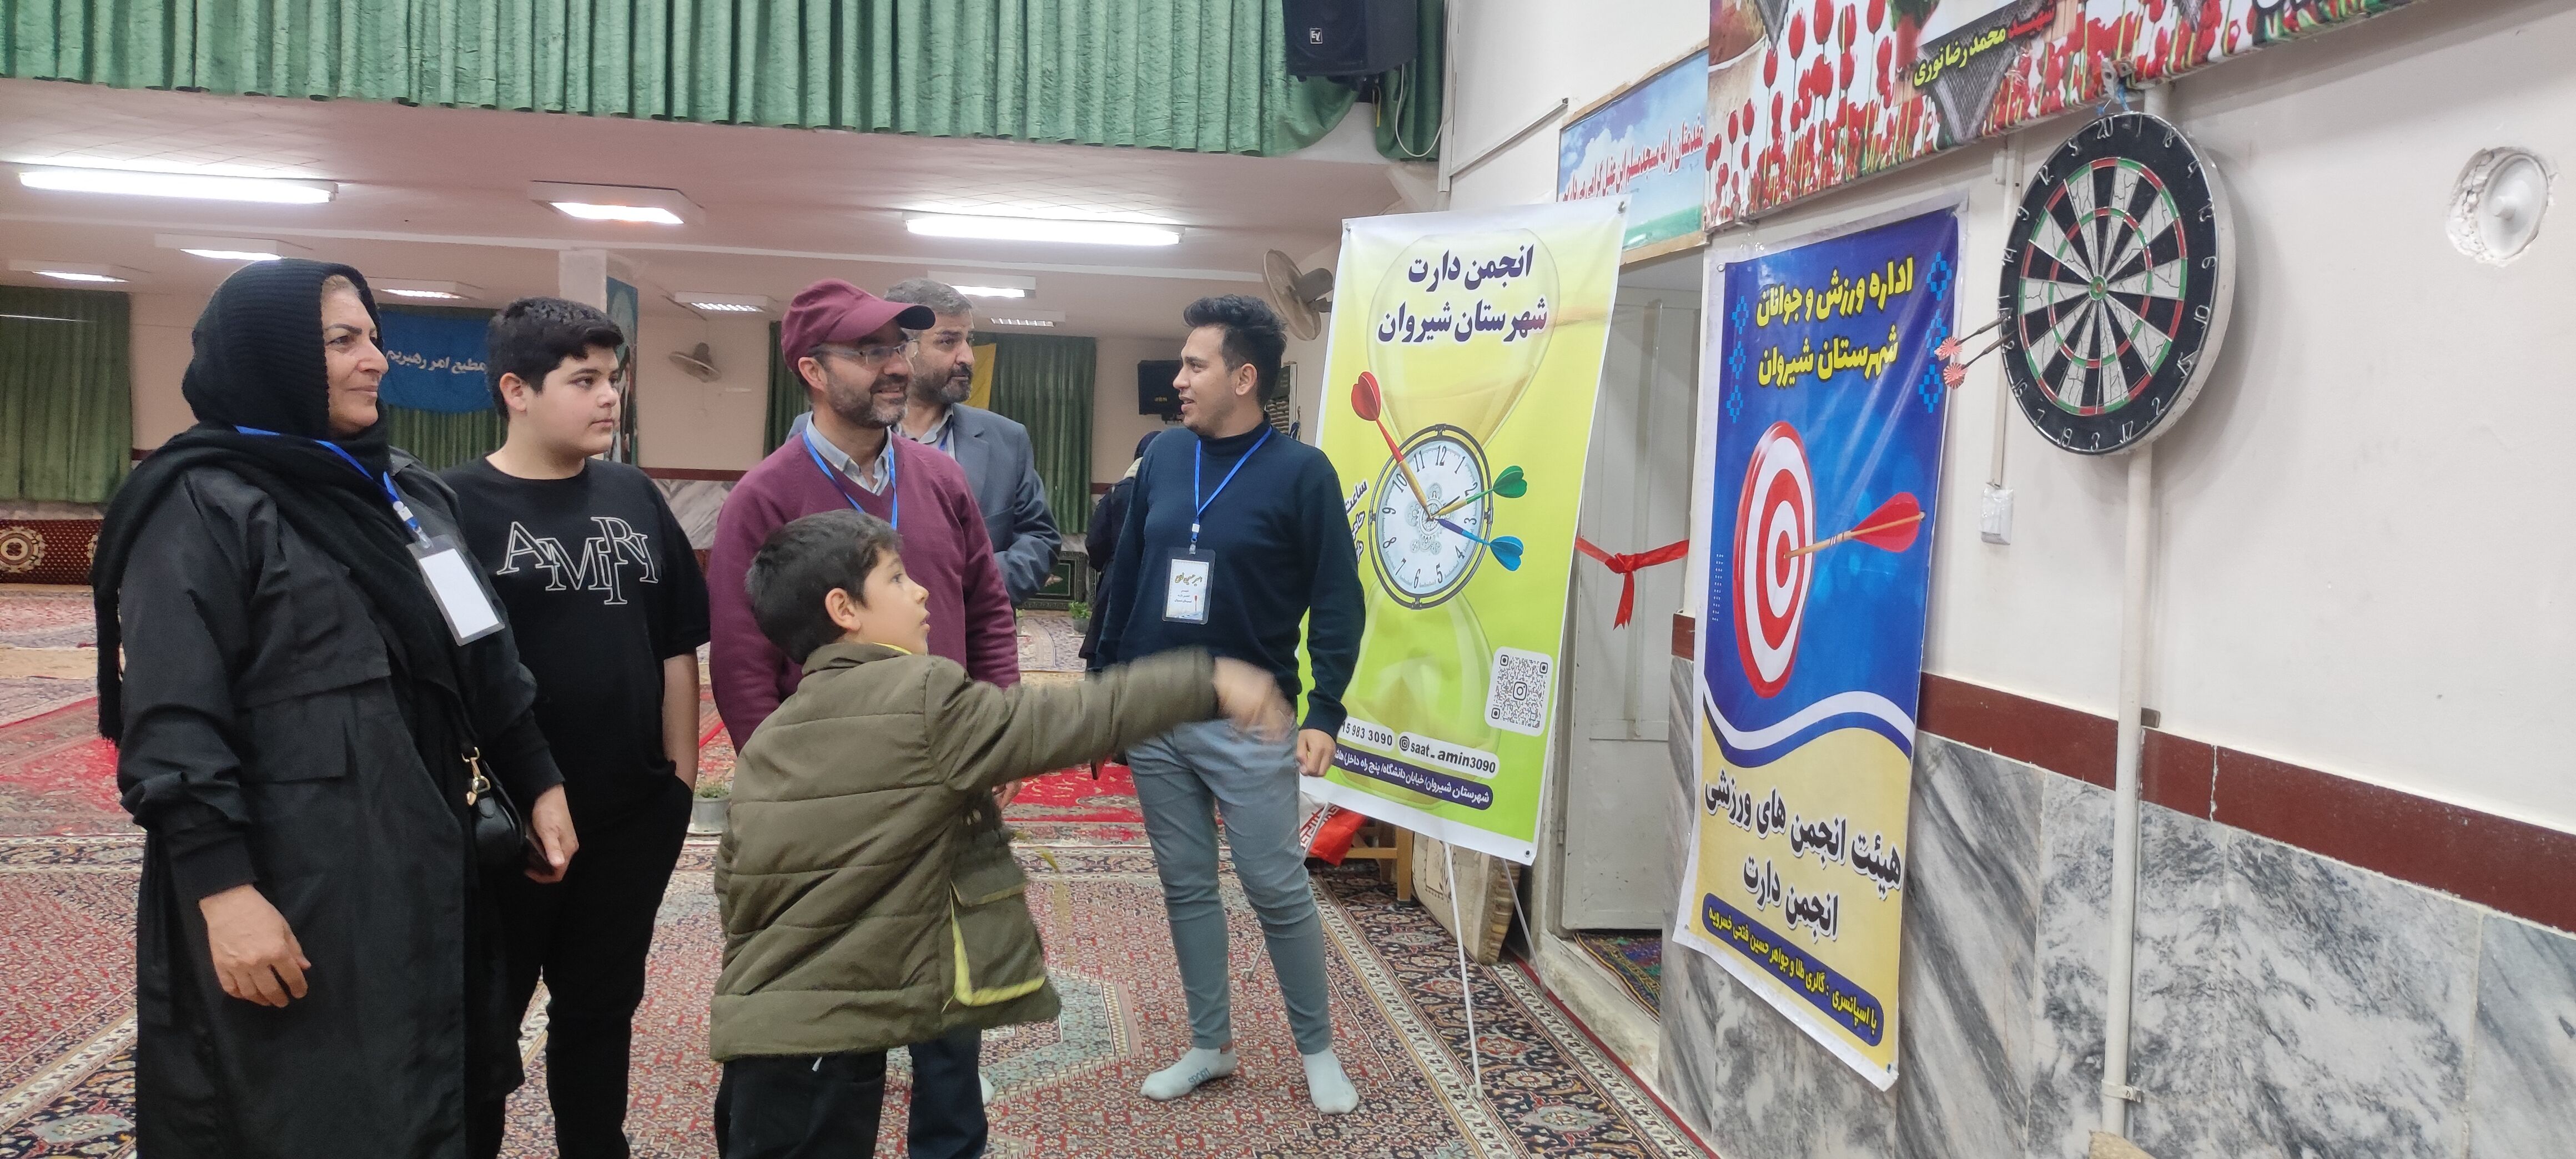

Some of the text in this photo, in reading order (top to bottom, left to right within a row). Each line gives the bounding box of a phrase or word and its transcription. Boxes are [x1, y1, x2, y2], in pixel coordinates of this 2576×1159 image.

[1969, 28, 2006, 56] محمد
[1914, 47, 1944, 87] نوری
[1408, 244, 1535, 293] انجمن دارت
[1756, 256, 1914, 327] اداره ورزش و جوانان
[1378, 298, 1548, 343] شهرستان شیروان
[427, 356, 450, 371] امر
[451, 357, 487, 374] مطیع
[1758, 325, 1899, 387] شهرستان شیروان
[1435, 445, 1447, 466] 12
[1342, 721, 1392, 746] 15 983 3090
[1368, 761, 1380, 776] پنج
[1452, 785, 1490, 804] شهرستان
[1705, 769, 1901, 898] هیئت انجمن های ورزشی
[1744, 856, 1838, 941] انجمن دارت
[1733, 924, 1749, 942] فتحی
[1750, 935, 1769, 954] حسین
[1769, 948, 1789, 972] جواهر
[1789, 960, 1794, 977] و
[1795, 958, 1805, 979] طلا
[1805, 971, 1825, 993] گالری
[1832, 991, 1870, 1026] اسپانسری
[1871, 1008, 1878, 1036] با
